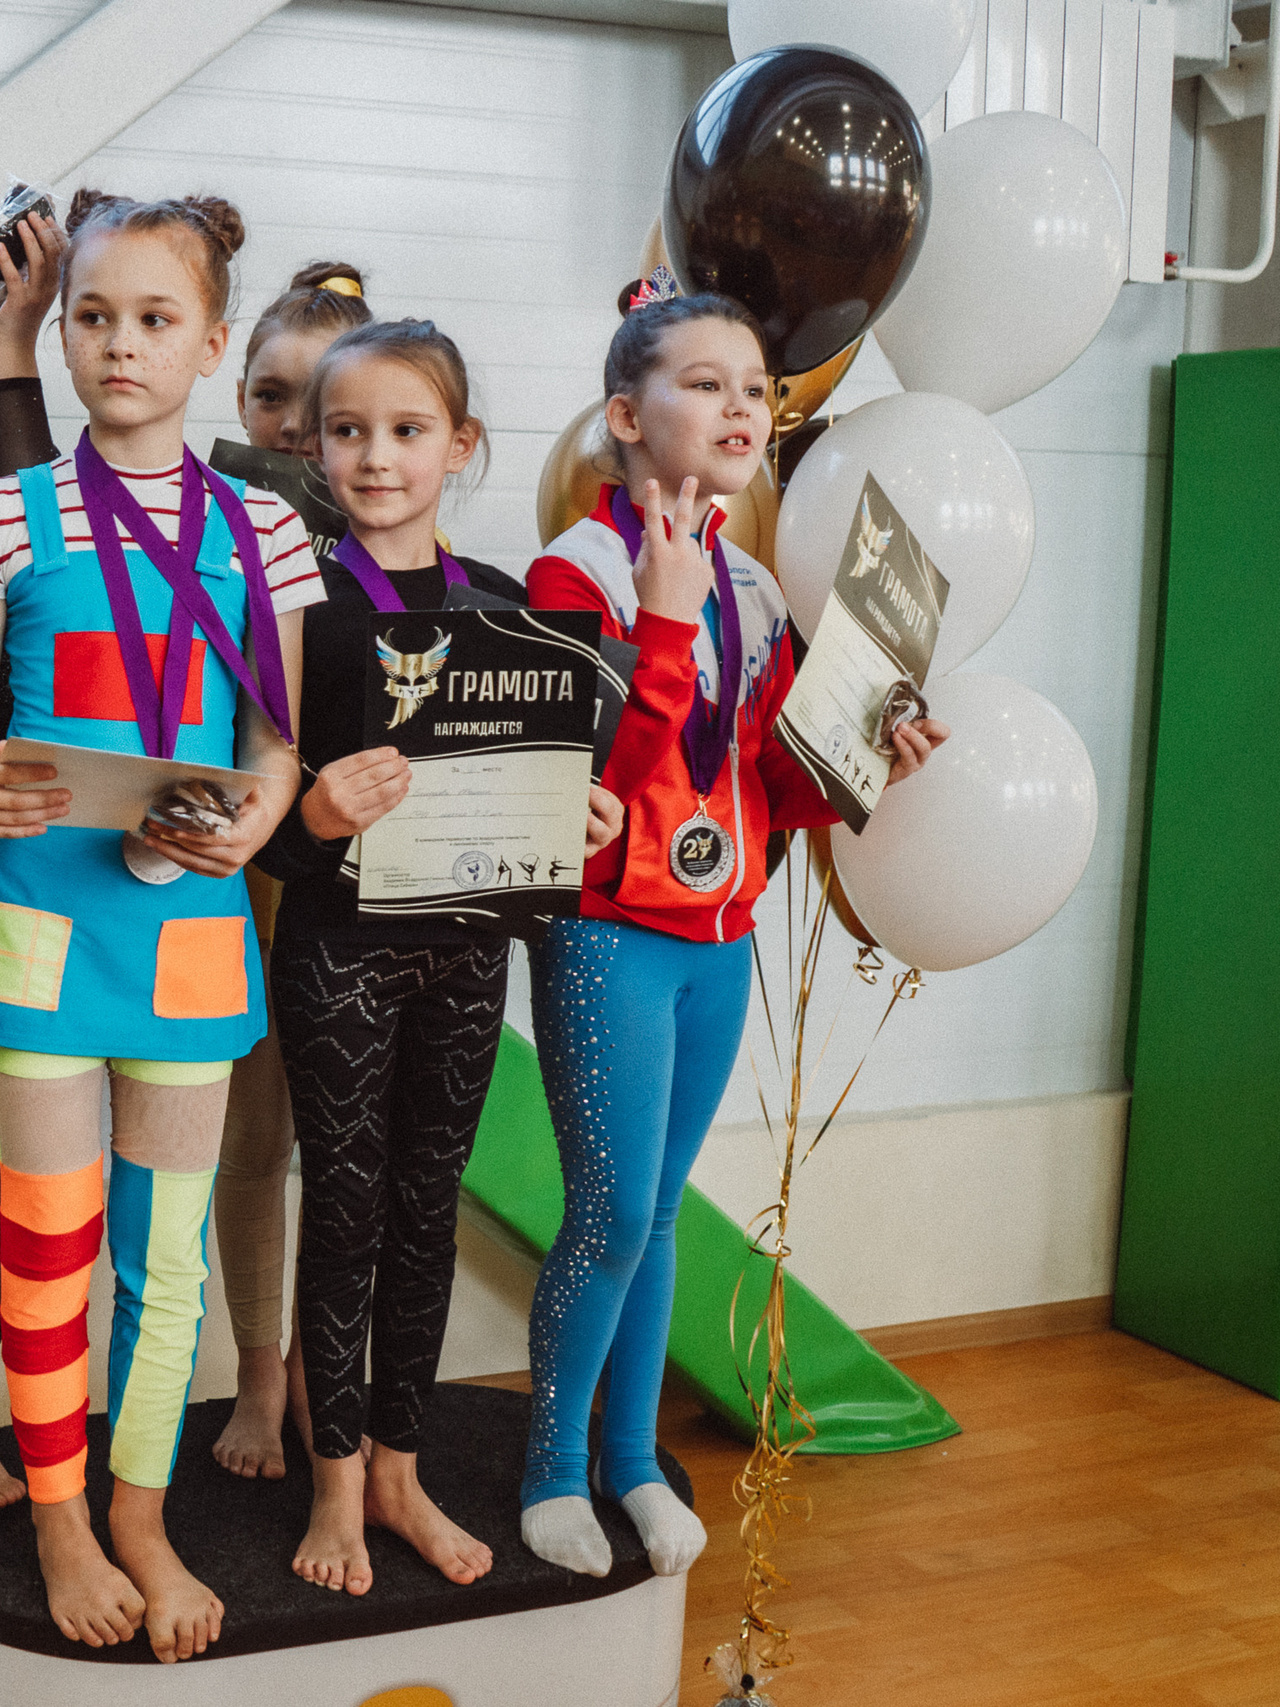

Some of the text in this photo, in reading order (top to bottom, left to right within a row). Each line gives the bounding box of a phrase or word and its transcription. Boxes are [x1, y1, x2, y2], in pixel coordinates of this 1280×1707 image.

[878, 560, 930, 645] ГРАМОТА
[448, 670, 574, 702] ГРАМОТА
[434, 721, 523, 737] НАГРАЖДАЕТСЯ
